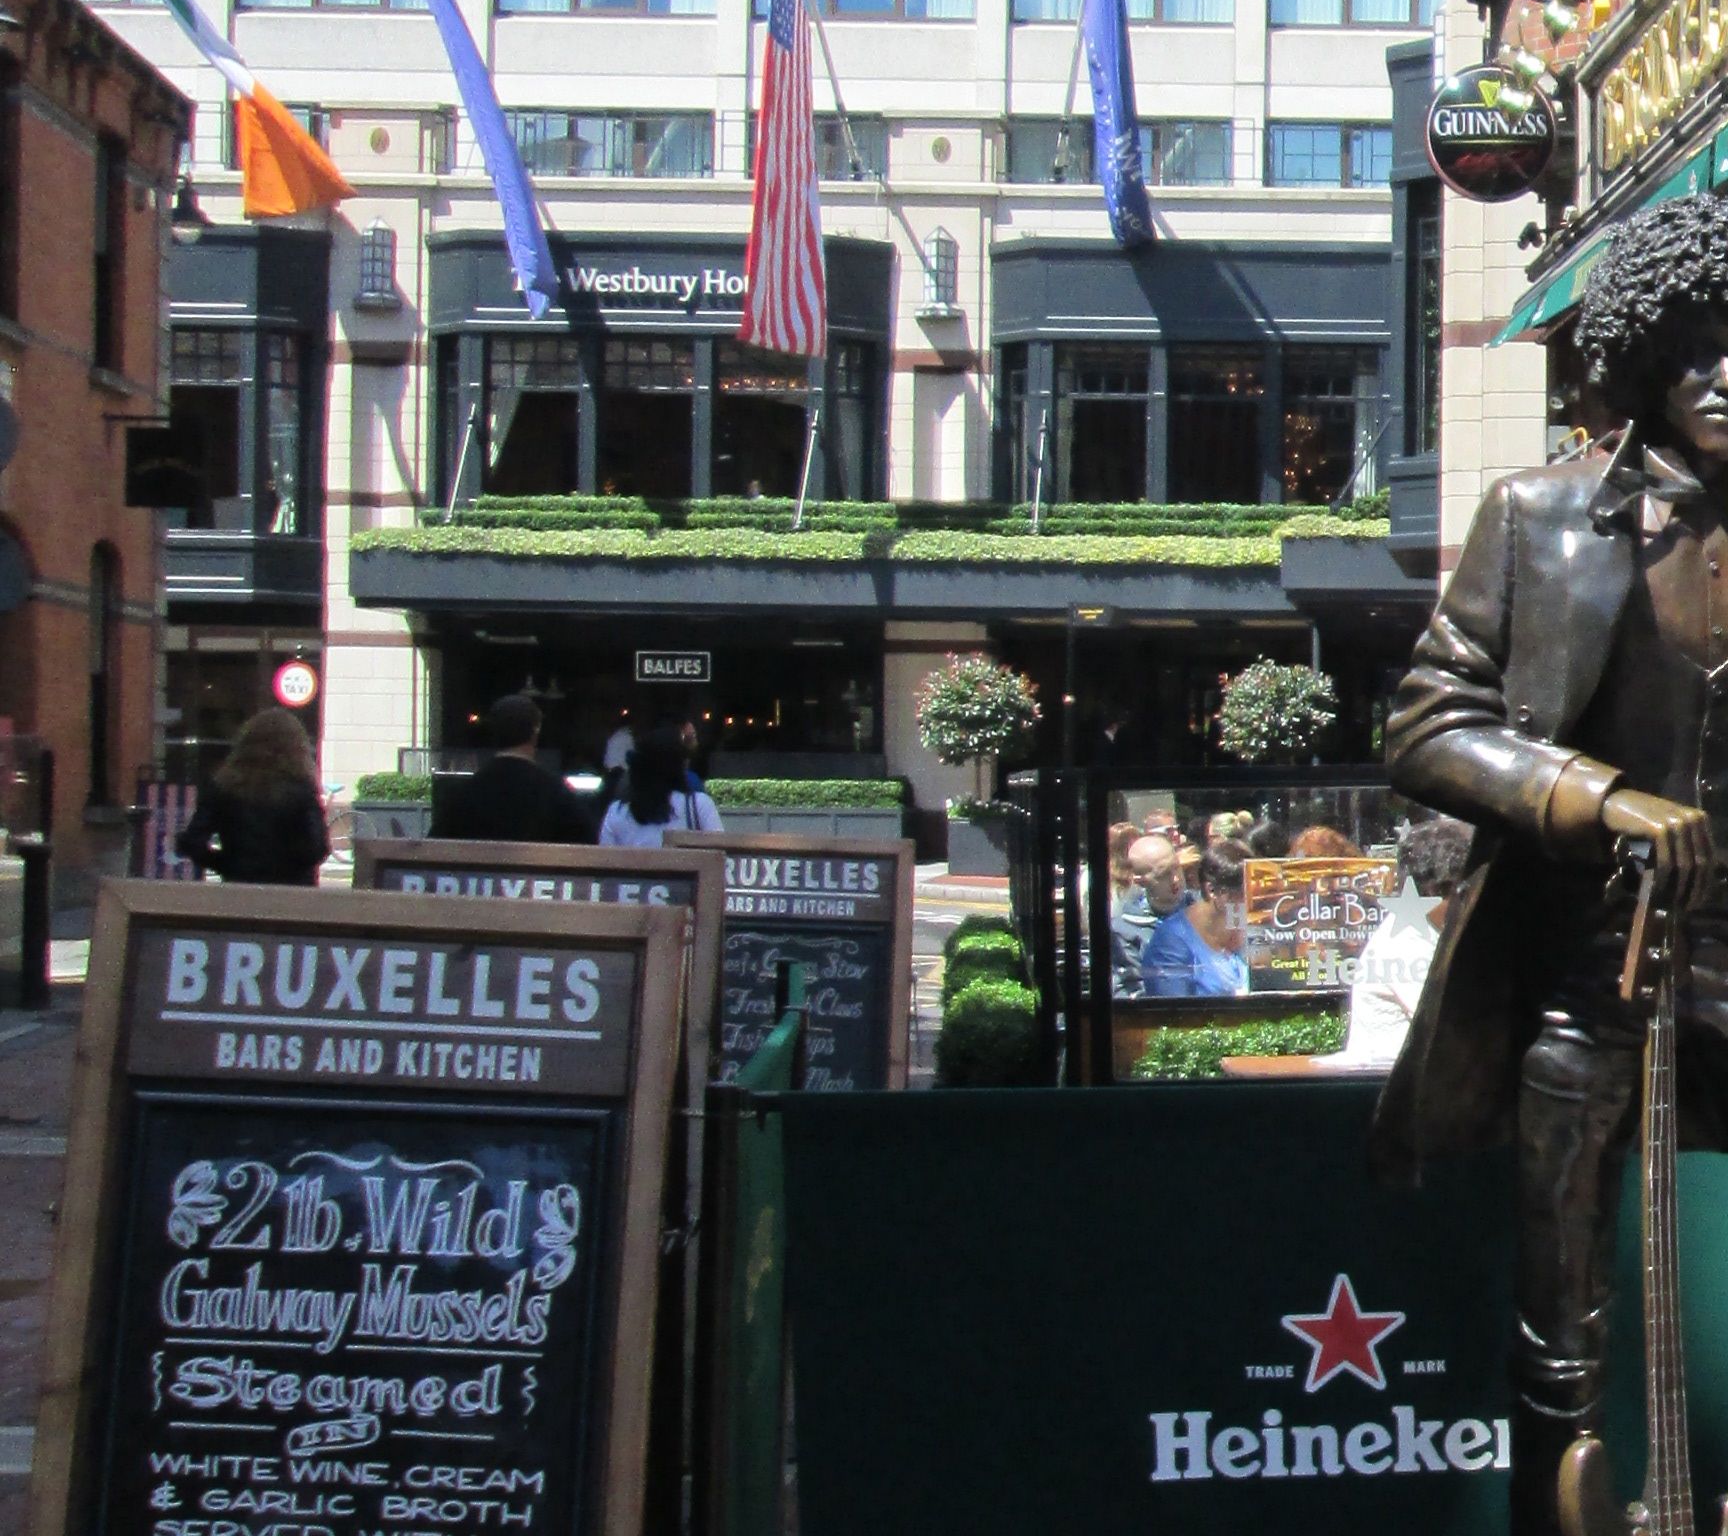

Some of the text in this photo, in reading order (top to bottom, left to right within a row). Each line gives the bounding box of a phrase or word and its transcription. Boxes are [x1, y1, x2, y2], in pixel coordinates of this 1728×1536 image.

[568, 267, 698, 301] Westbury
[703, 269, 749, 295] Hot
[644, 658, 702, 675] BALFES
[724, 858, 881, 892] RUXELLES
[726, 895, 856, 917] ARS AND KITCHEN
[1273, 894, 1341, 928] Cellar
[1345, 893, 1389, 925] Bar
[1264, 929, 1296, 941] Now
[1299, 927, 1336, 944] Open
[167, 938, 601, 1023] BRUXELLES
[1306, 948, 1430, 985] Heine
[216, 1032, 542, 1082] BARS AND KITCHEN
[363, 1176, 528, 1259] Wild
[160, 1258, 552, 1354] Galway Mussels
[170, 1355, 503, 1416] Steamed
[1245, 1359, 1447, 1379] TRADE MARK
[301, 1420, 368, 1448] IN
[149, 1451, 280, 1482] WHITE
[405, 1465, 545, 1495] CREAM
[149, 1481, 533, 1528] & GARLIC BROTH
